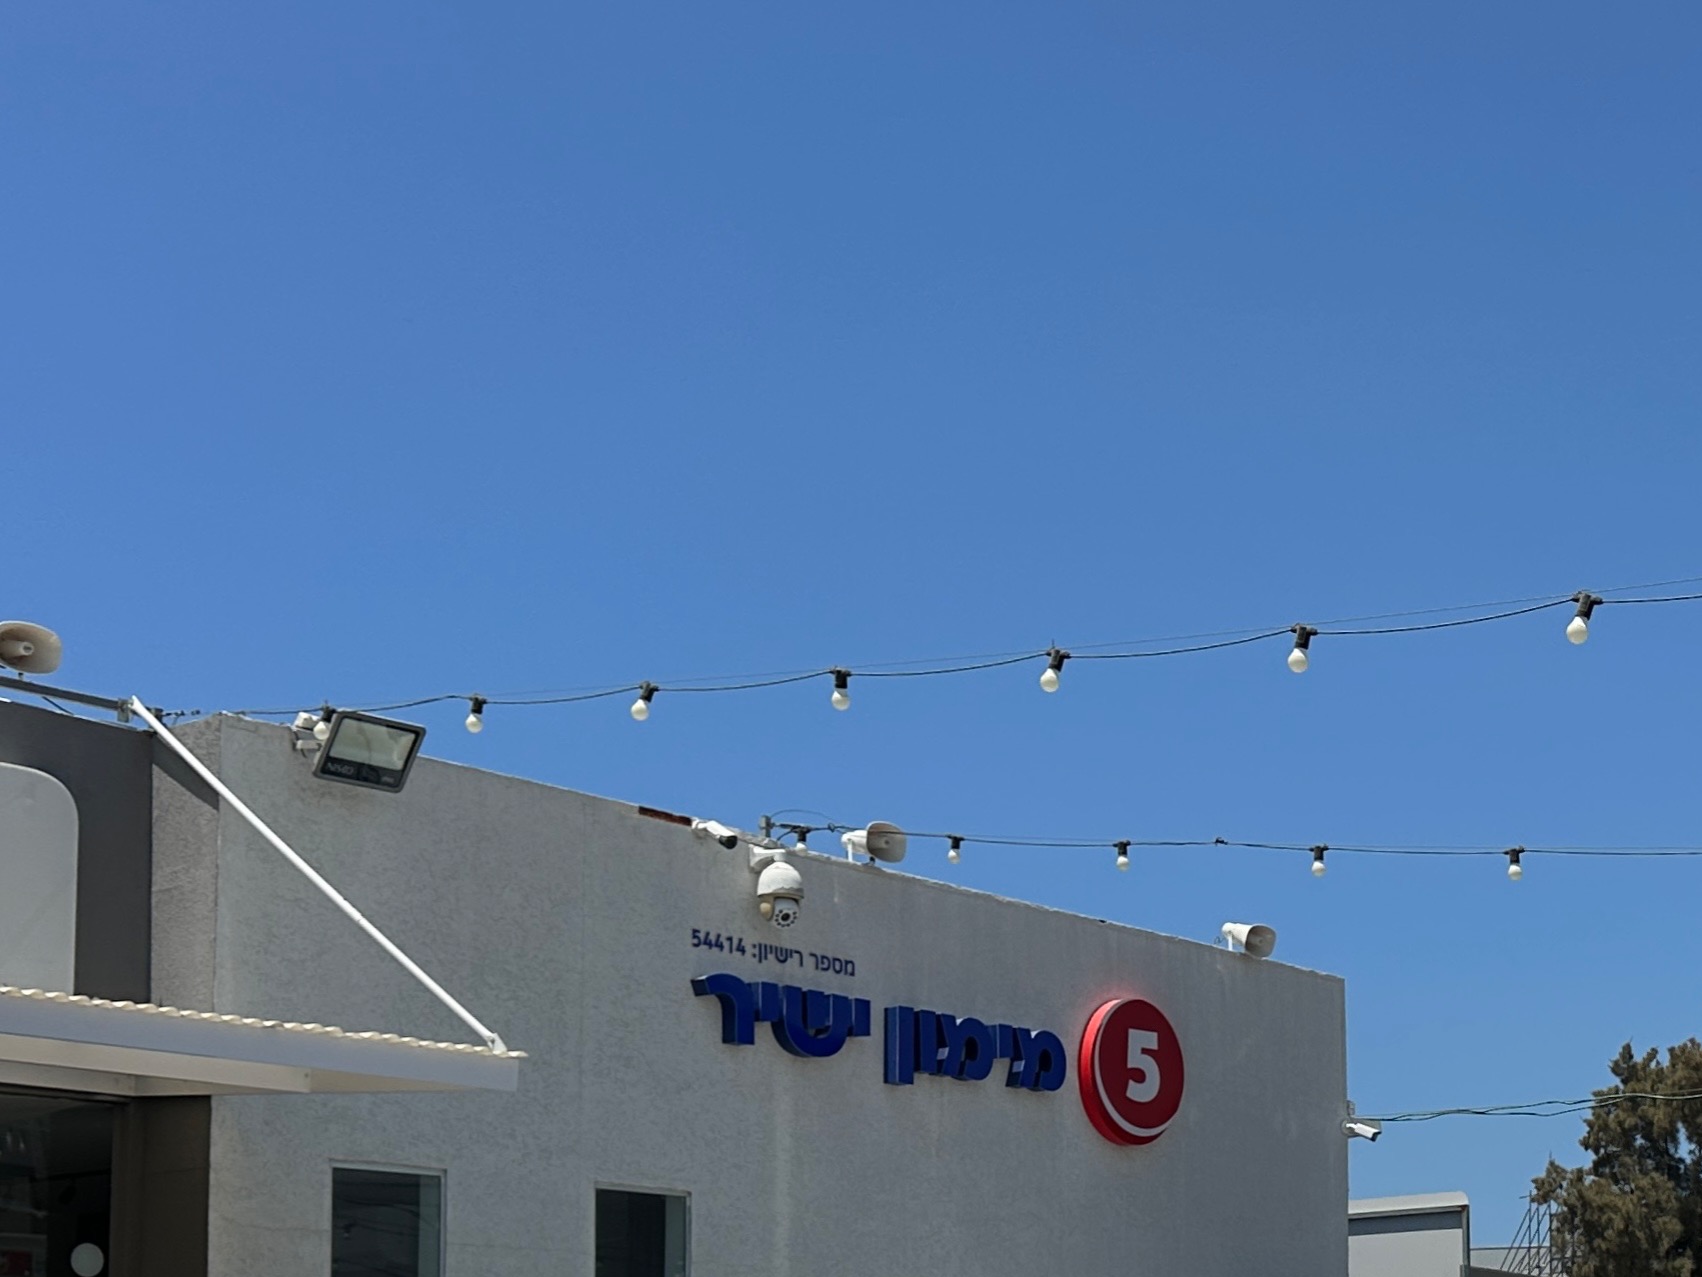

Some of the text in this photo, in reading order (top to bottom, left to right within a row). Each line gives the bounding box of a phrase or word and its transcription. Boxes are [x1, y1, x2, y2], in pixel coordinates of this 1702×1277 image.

[691, 927, 856, 977] מספר רישיון: 54414
[690, 972, 1067, 1092] מימון ישיר
[1125, 1027, 1161, 1104] 5
